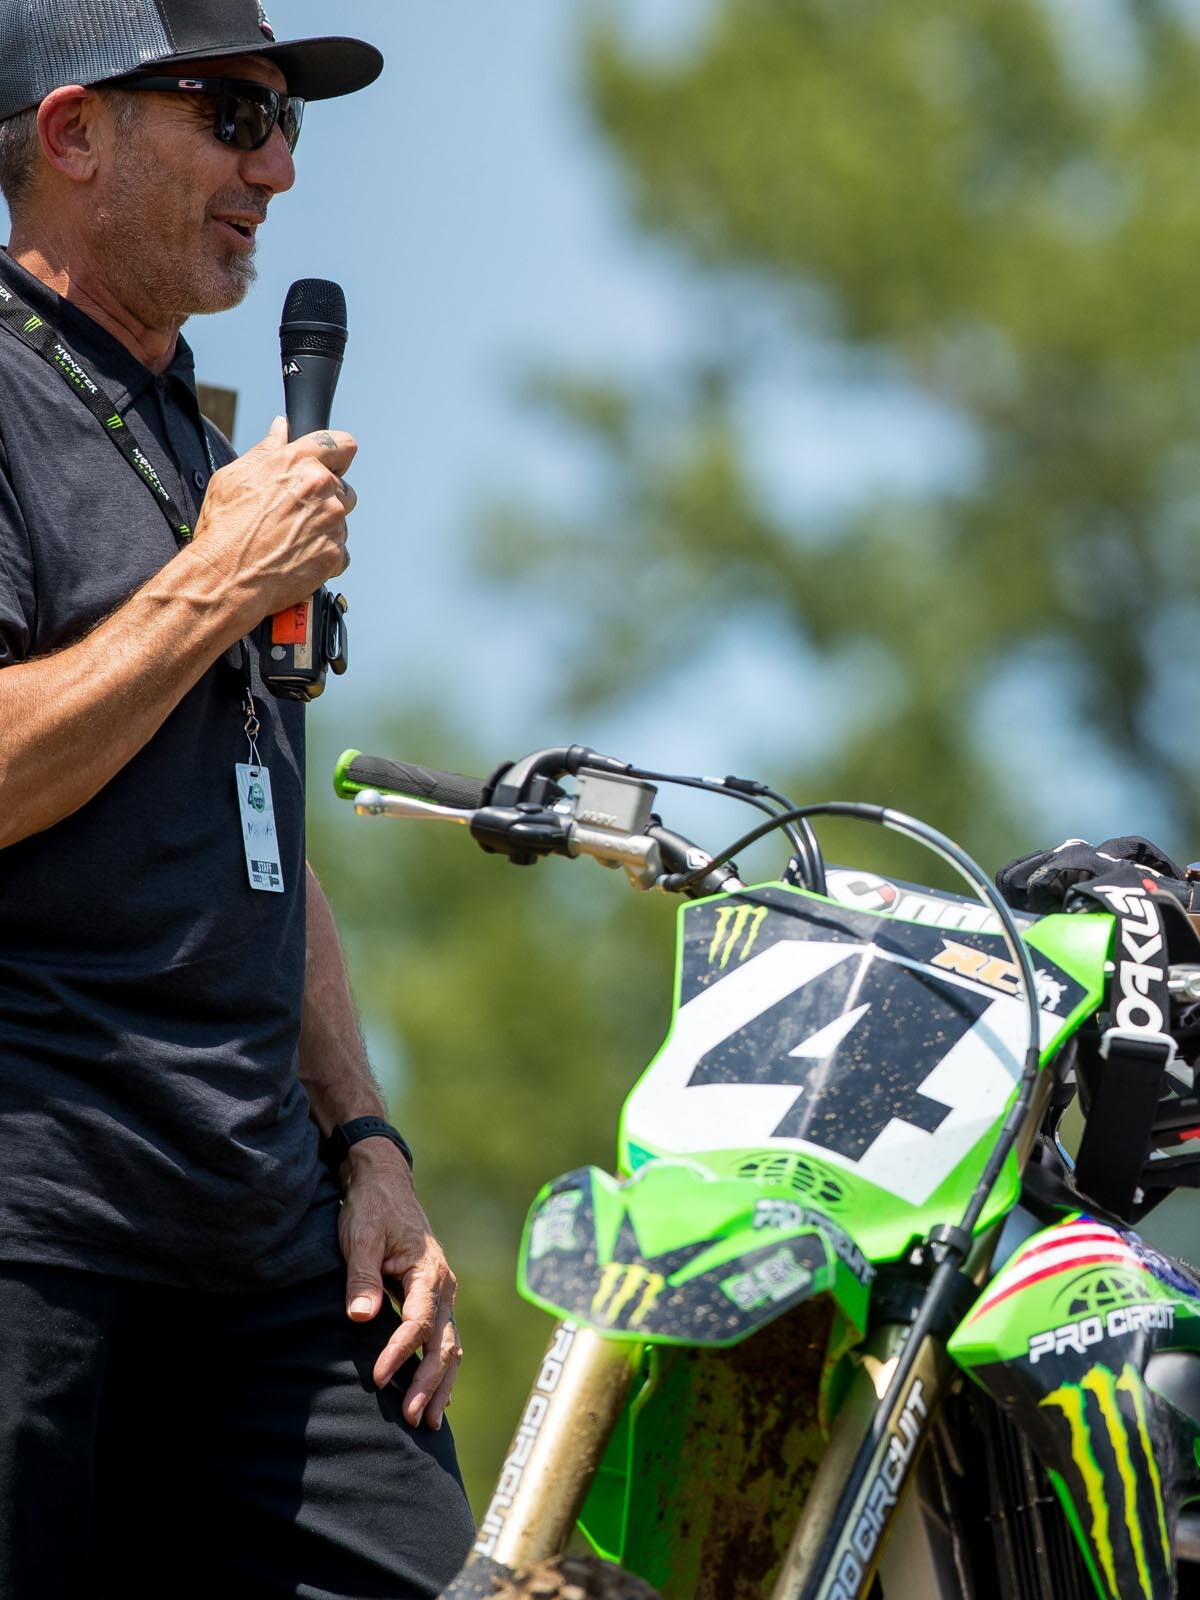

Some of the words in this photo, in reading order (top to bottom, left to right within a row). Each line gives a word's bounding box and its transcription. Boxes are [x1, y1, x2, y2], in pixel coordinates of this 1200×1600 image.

[54, 344, 98, 394] MONSTER
[257, 861, 273, 874] STAFF
[1092, 885, 1164, 1033] OAKLEY
[684, 951, 996, 1163] 4
[1028, 1316, 1104, 1365] PRO
[1106, 1303, 1176, 1338] CIRCUIT
[852, 1378, 928, 1562] CIRCUIT
